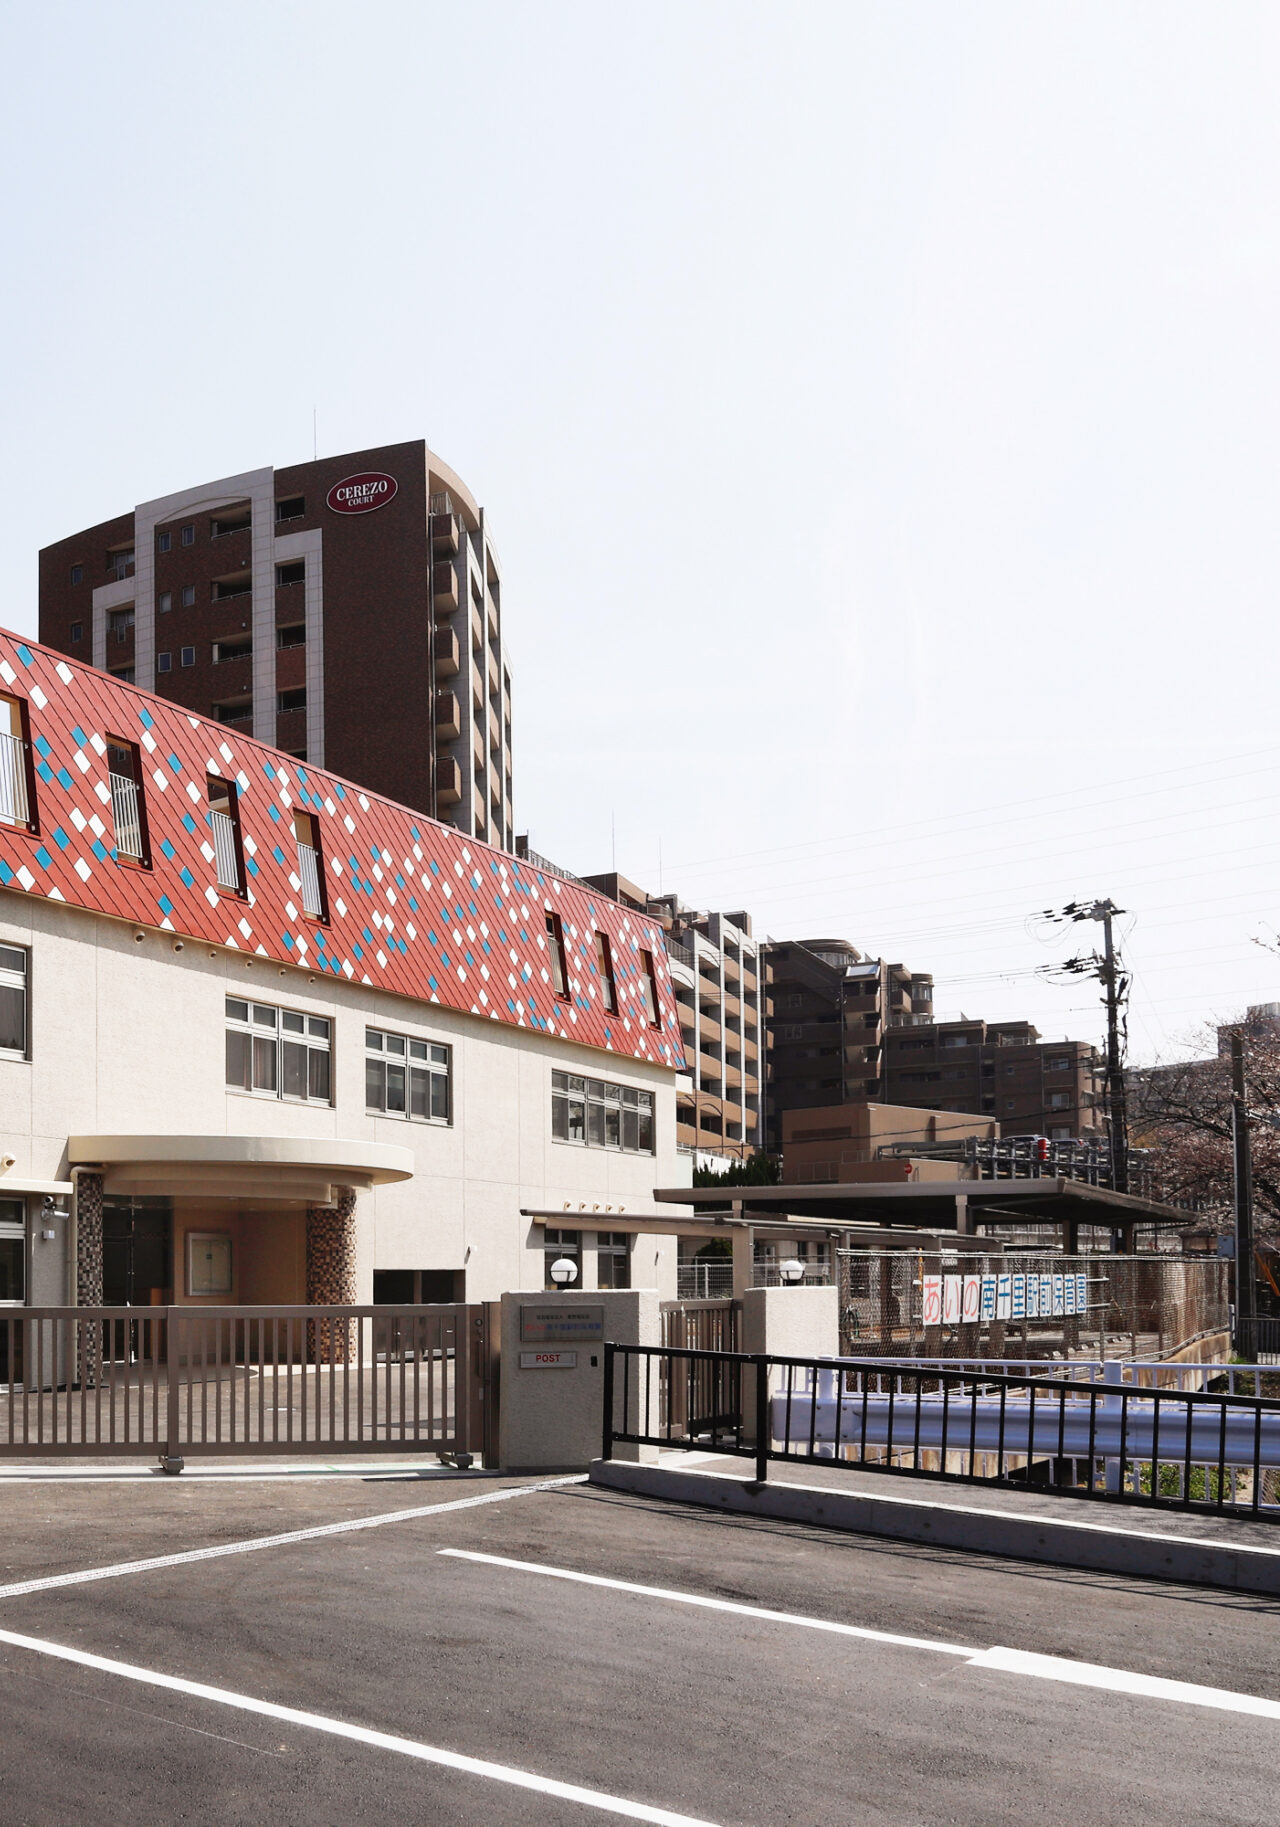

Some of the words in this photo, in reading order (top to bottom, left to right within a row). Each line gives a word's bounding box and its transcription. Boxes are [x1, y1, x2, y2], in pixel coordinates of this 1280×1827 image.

[336, 480, 388, 501] CEREZO
[348, 495, 374, 507] COURT
[924, 1275, 1086, 1323] あいの南千里駅前保育園
[536, 1354, 561, 1363] POST
